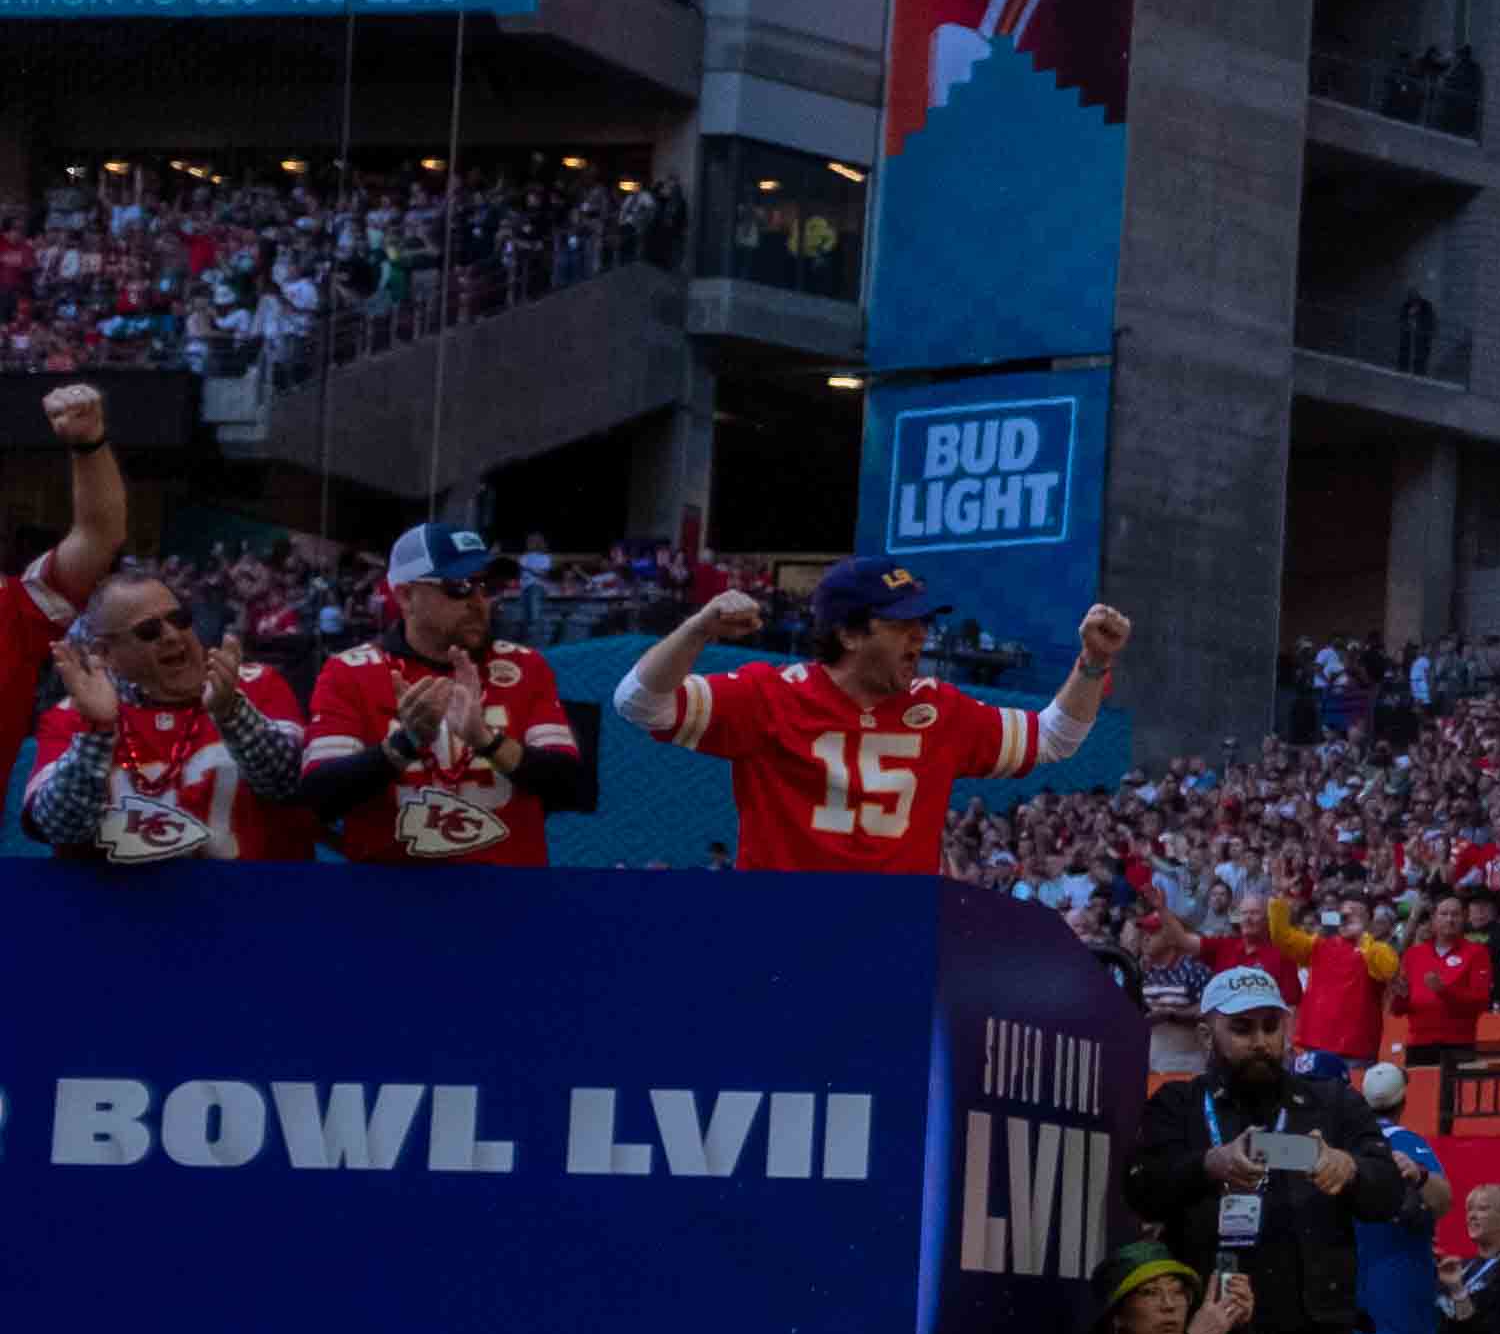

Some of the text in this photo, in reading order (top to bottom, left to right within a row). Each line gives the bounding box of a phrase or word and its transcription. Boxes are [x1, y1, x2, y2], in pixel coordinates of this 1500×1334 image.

[923, 417, 1040, 479] BUD
[897, 472, 1059, 537] LIGHT
[811, 731, 923, 837] 15
[49, 1078, 873, 1180] BOWL LVII
[959, 1109, 1111, 1281] LVII
